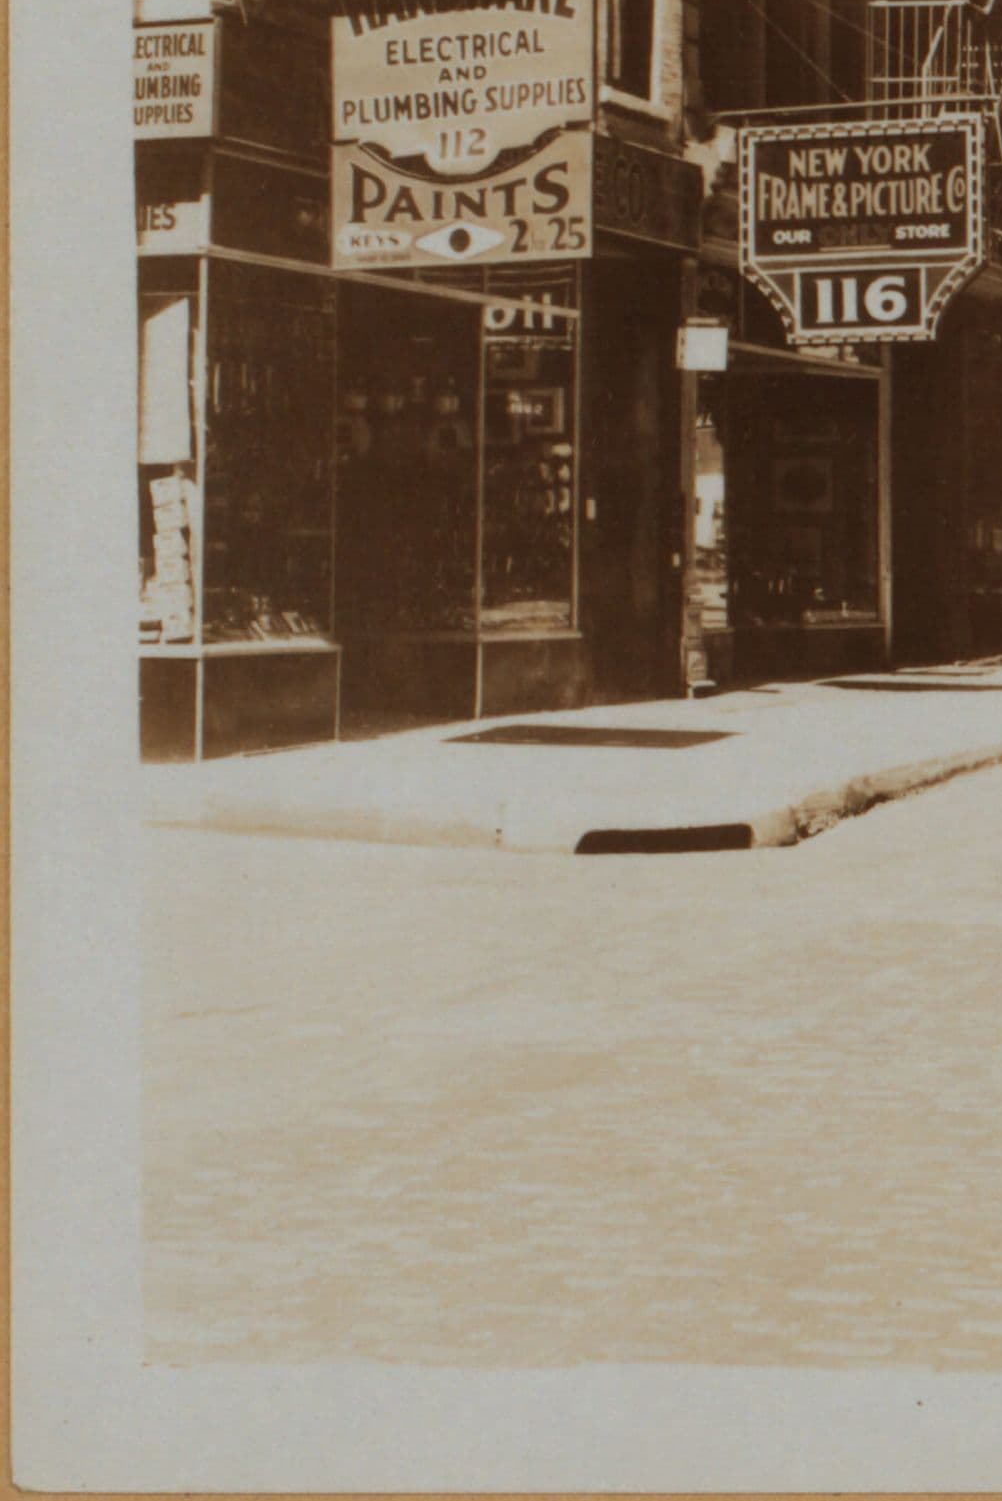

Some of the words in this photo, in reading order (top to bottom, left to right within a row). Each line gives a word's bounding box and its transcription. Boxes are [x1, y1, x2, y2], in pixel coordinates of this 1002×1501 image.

[385, 28, 545, 66] ELECTRICAL
[146, 62, 171, 72] AND
[438, 66, 487, 83] AND
[134, 73, 201, 100] UMBING
[342, 90, 478, 125] PLUMBING
[484, 77, 586, 112] SUPPLIES
[133, 102, 194, 127] UPPLIES
[439, 127, 487, 160] 112
[789, 148, 848, 178] NEW
[854, 143, 931, 175] YORK
[349, 162, 571, 224] PAINTS
[757, 171, 830, 221] FRAME
[832, 182, 848, 217] &
[850, 172, 943, 217] PICTURE
[349, 234, 400, 248] KEYS
[508, 218, 529, 253] 2
[548, 216, 587, 251] 25
[772, 229, 812, 245] OUR
[819, 225, 892, 247] ONLY
[895, 223, 950, 240] STORE
[814, 275, 908, 324] 116
